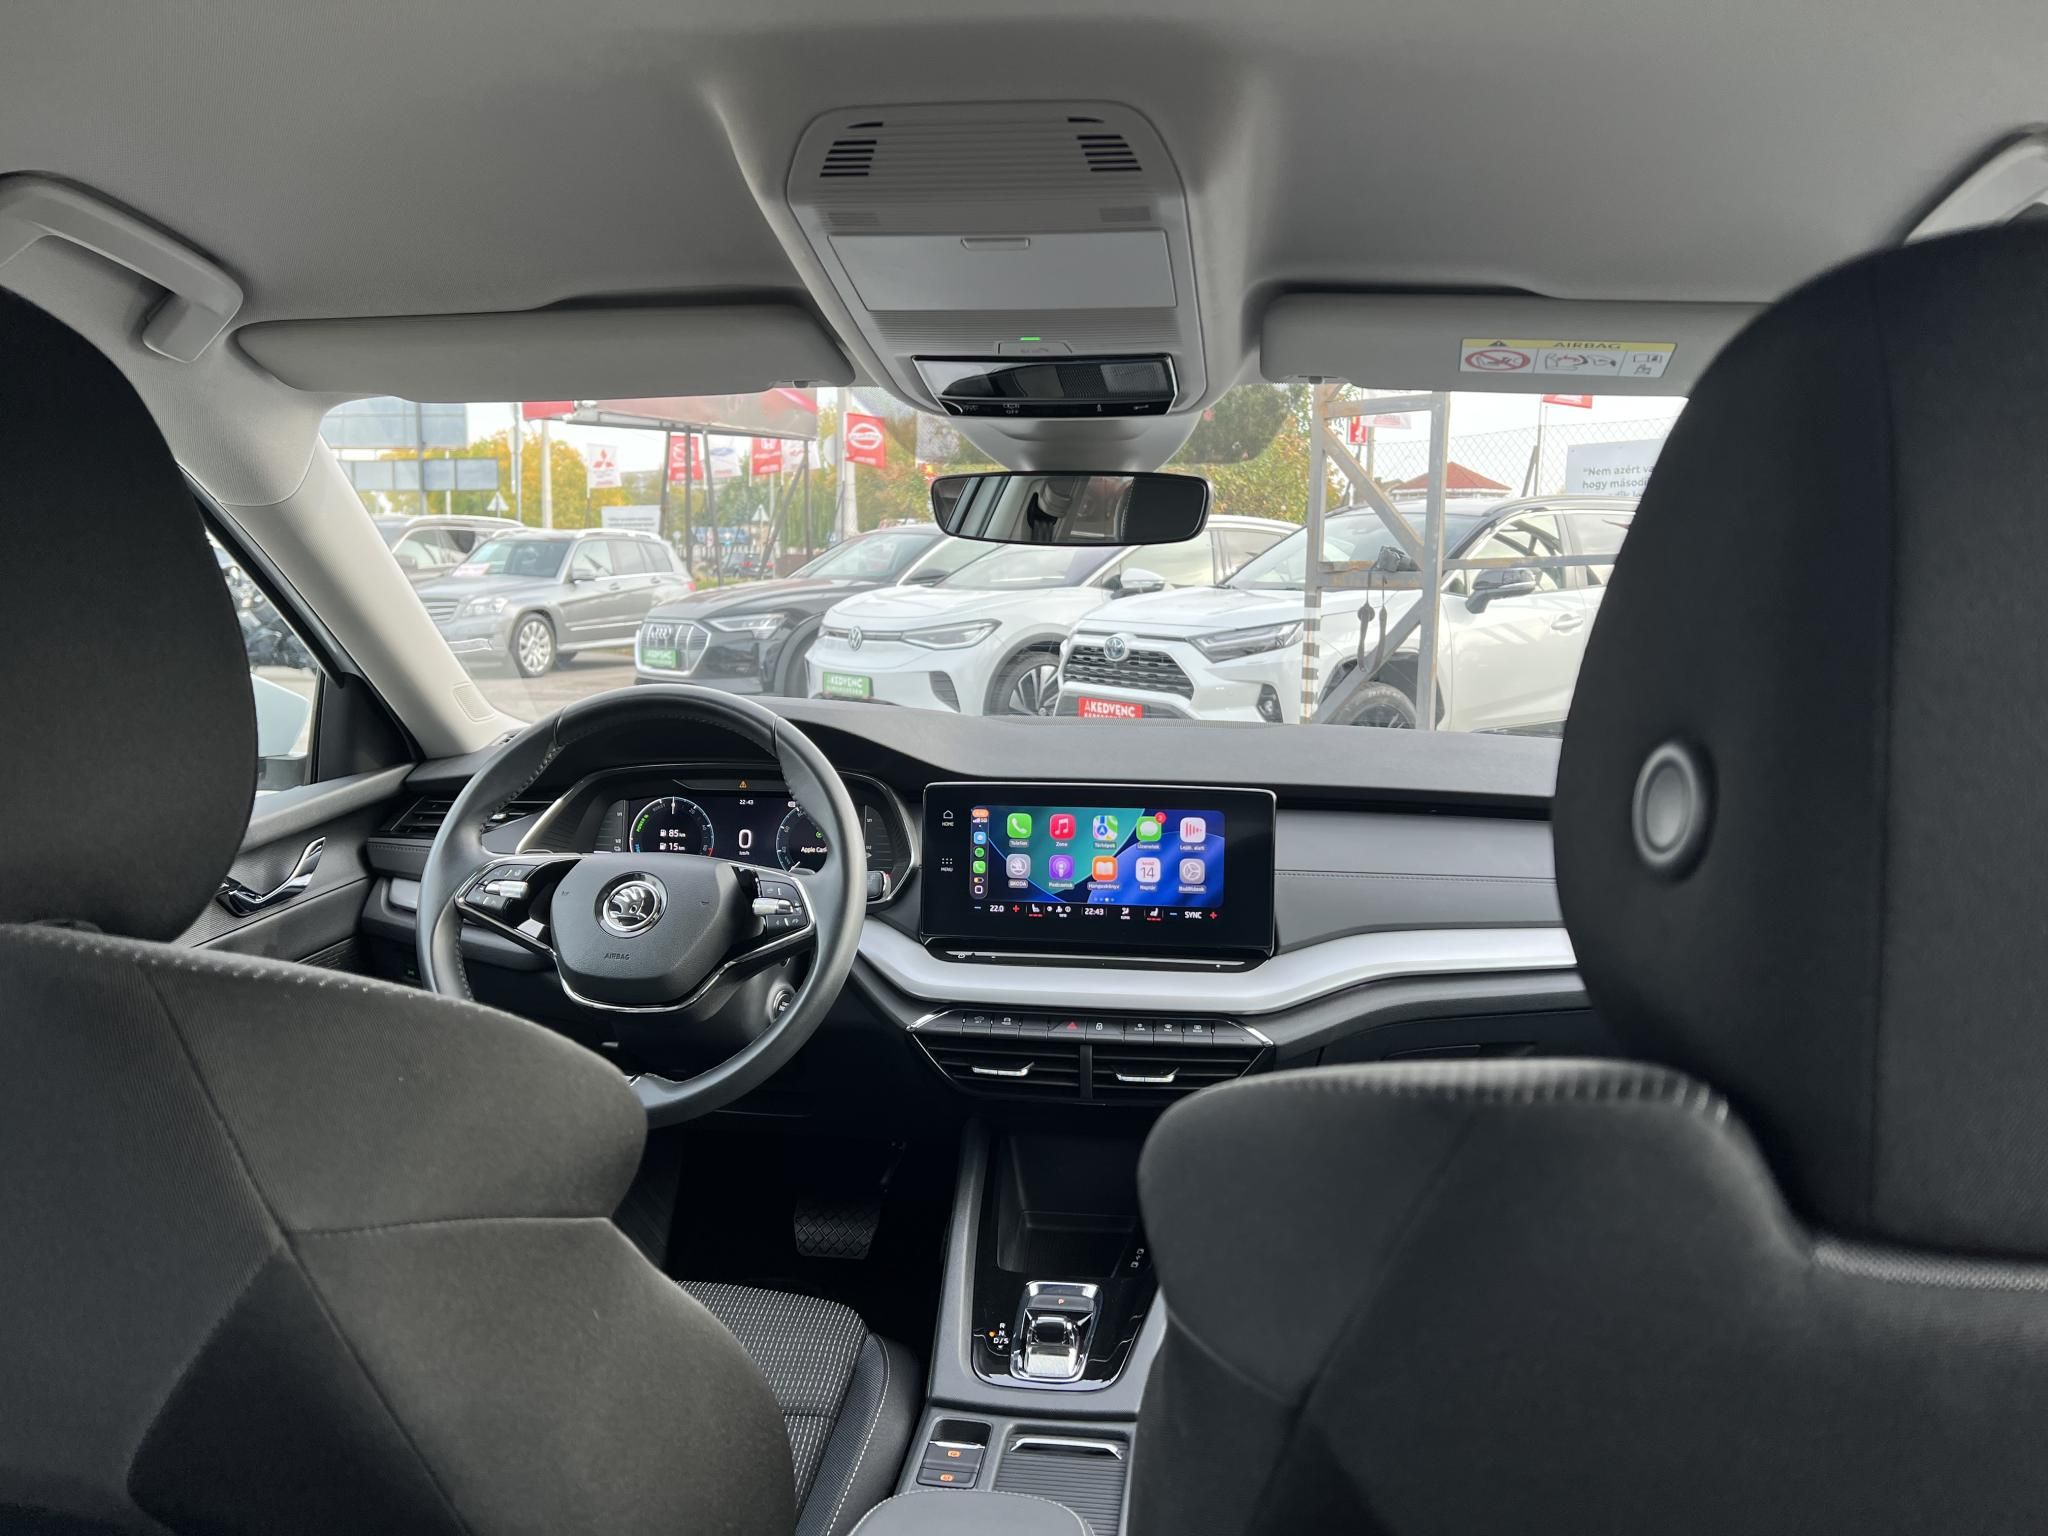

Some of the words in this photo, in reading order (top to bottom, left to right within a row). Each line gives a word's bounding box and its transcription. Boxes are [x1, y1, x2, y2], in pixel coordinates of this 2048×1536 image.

[1614, 465, 1641, 475] azért
[1582, 480, 1607, 490] hogy
[668, 830, 679, 838] 85
[738, 828, 752, 849] 0
[1140, 867, 1155, 879] 14
[1184, 911, 1202, 919] SYNC
[604, 952, 631, 960] AIRBAG
